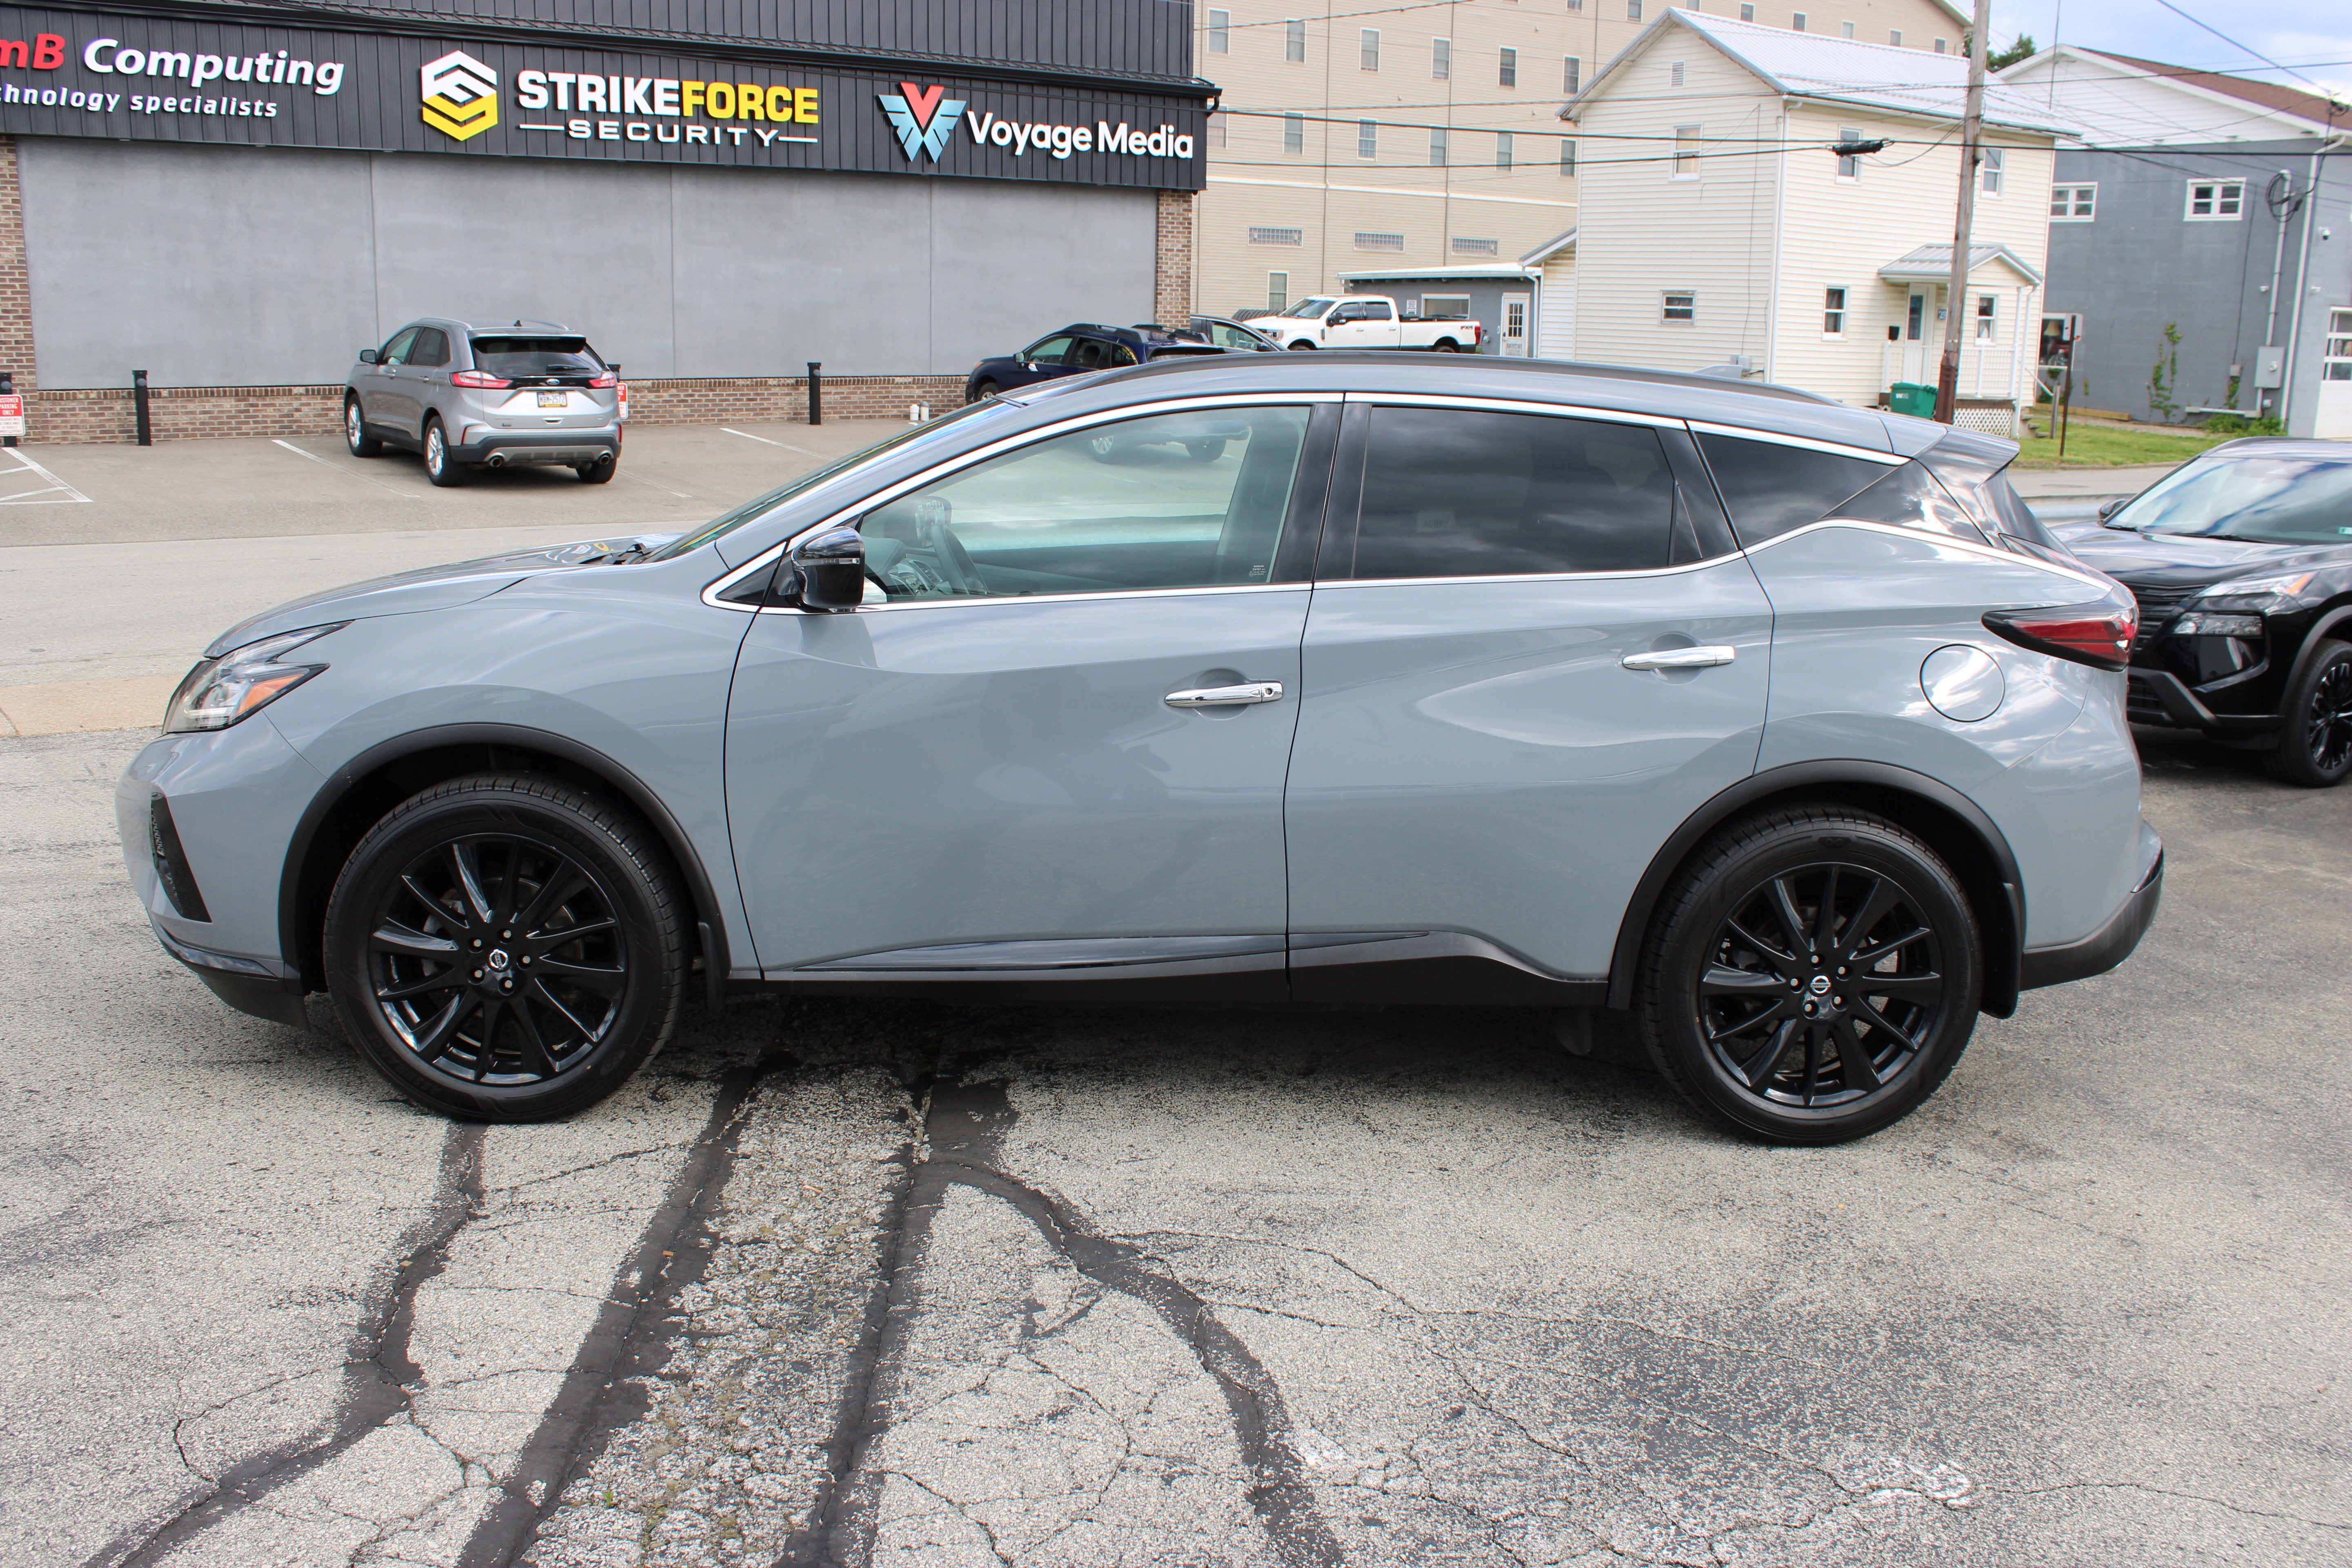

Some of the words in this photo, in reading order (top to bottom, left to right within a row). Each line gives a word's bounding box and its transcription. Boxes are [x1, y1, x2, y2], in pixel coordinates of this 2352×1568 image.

[84, 38, 345, 95] Computing
[0, 82, 121, 112] hnology
[130, 95, 277, 117] specialists
[518, 70, 818, 124] STRIKEFORCE
[568, 119, 779, 147] SECURITY
[967, 110, 1093, 160] Voyage
[1098, 121, 1194, 159] Media
